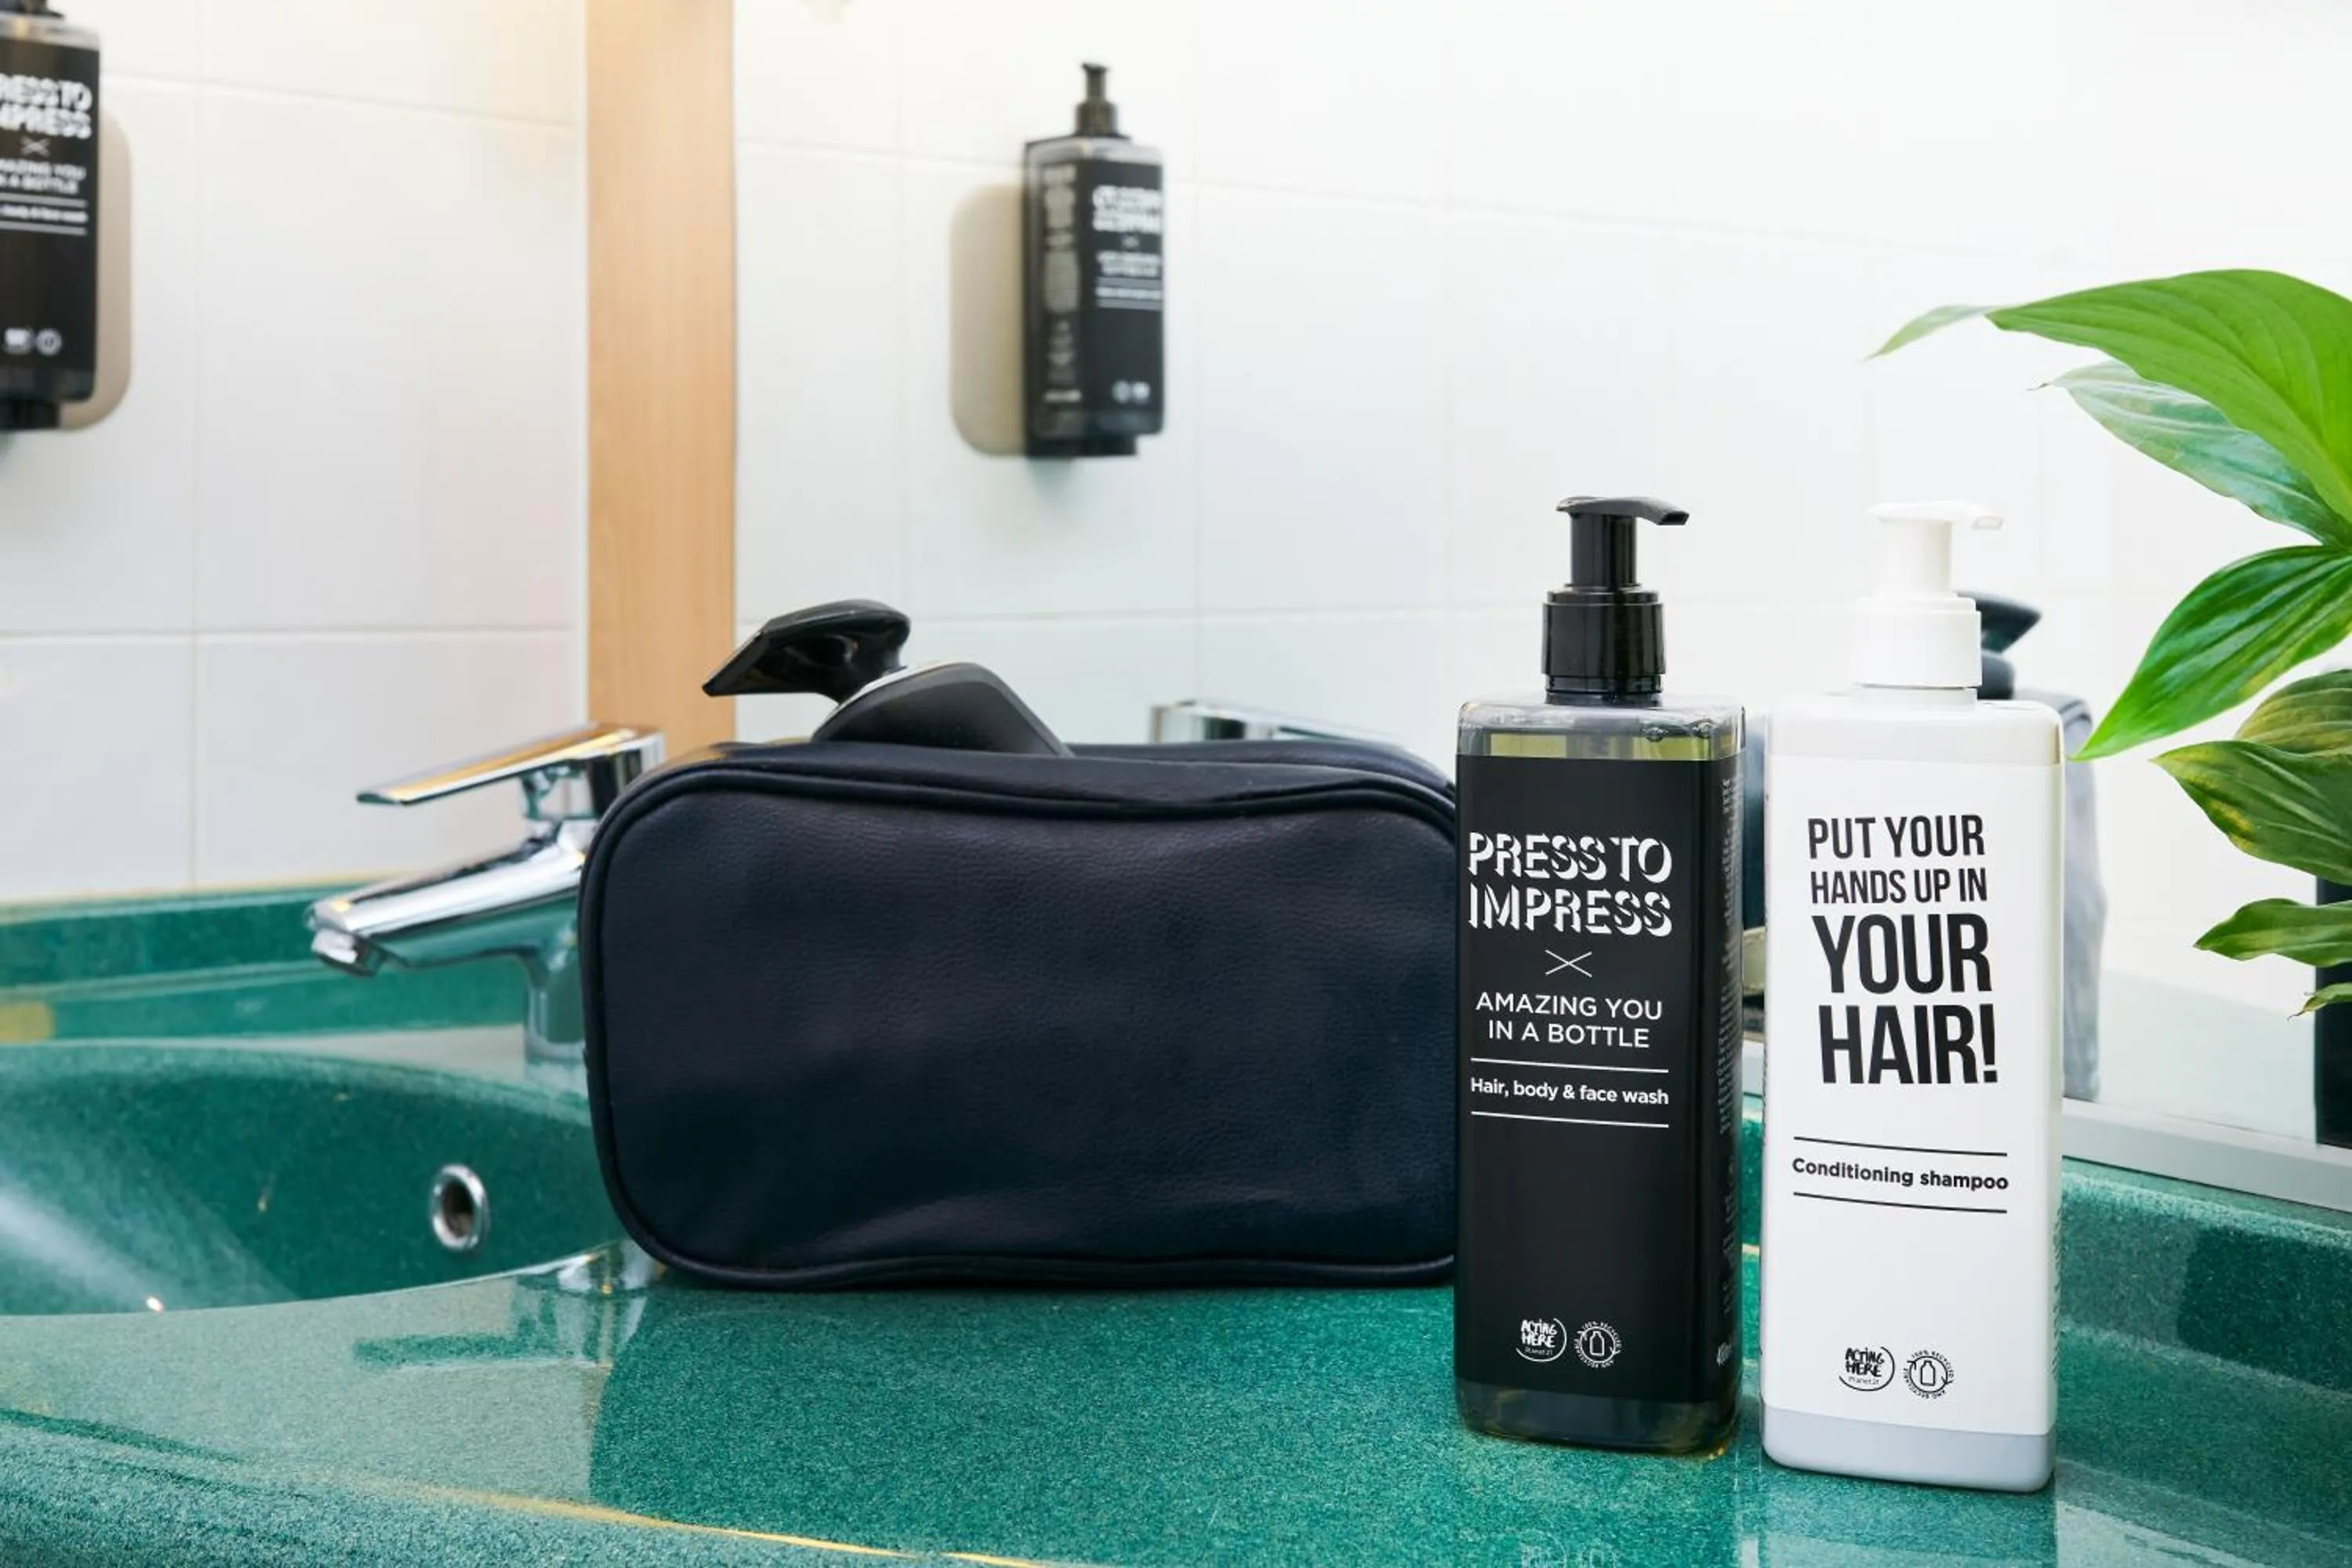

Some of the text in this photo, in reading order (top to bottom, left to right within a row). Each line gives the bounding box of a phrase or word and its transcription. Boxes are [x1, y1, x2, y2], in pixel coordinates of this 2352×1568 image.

[0, 74, 59, 108] RESS
[1808, 815, 1985, 859] PUT YOUR
[1467, 832, 1672, 884] PRESS TO
[1810, 867, 1987, 904] HANDS UP IN
[1468, 882, 1672, 937] IMPRESS
[1811, 913, 1992, 995] YOUR
[1475, 991, 1663, 1021] AMAZING YOU
[1489, 1019, 1650, 1048] IN A BOTTLE
[1818, 1003, 1998, 1084] HAIR!
[1470, 1076, 1669, 1105] Hair, body & face wash
[1792, 1157, 2009, 1192] Conditioning shampoo
[1522, 1332, 1555, 1348] HERE
[1846, 1360, 1882, 1377] HERE
